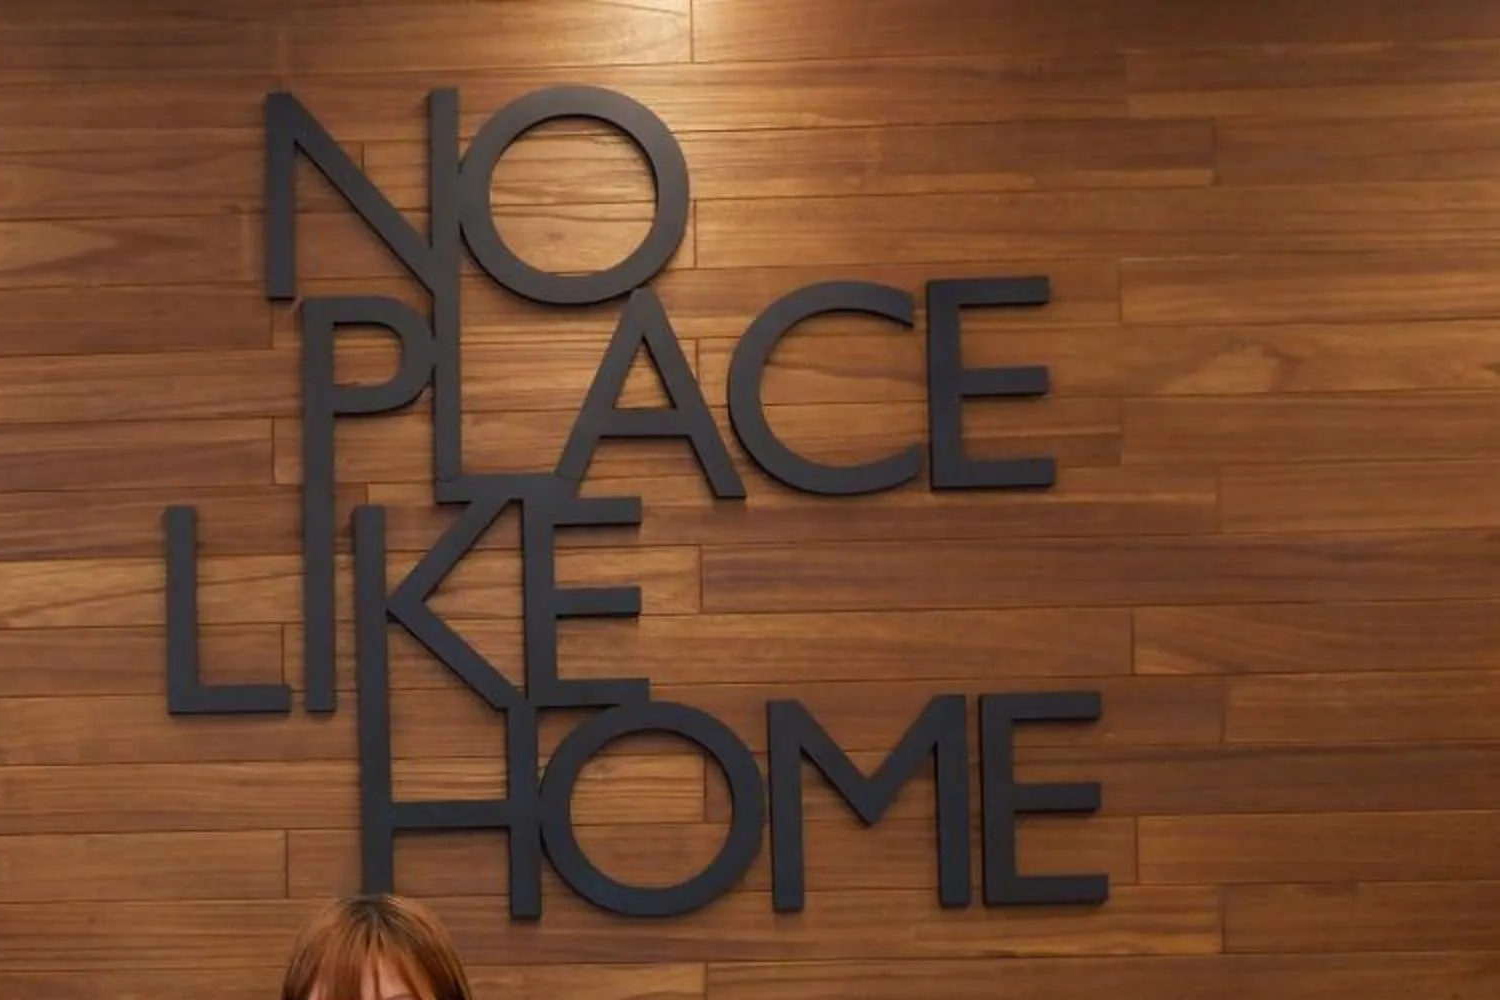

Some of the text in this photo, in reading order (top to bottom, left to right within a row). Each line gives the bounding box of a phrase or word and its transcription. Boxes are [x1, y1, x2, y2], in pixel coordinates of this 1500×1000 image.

[265, 84, 689, 305] NO
[300, 276, 1055, 502] PLACE
[166, 496, 649, 714] LIKE
[356, 690, 1109, 919] HOME
